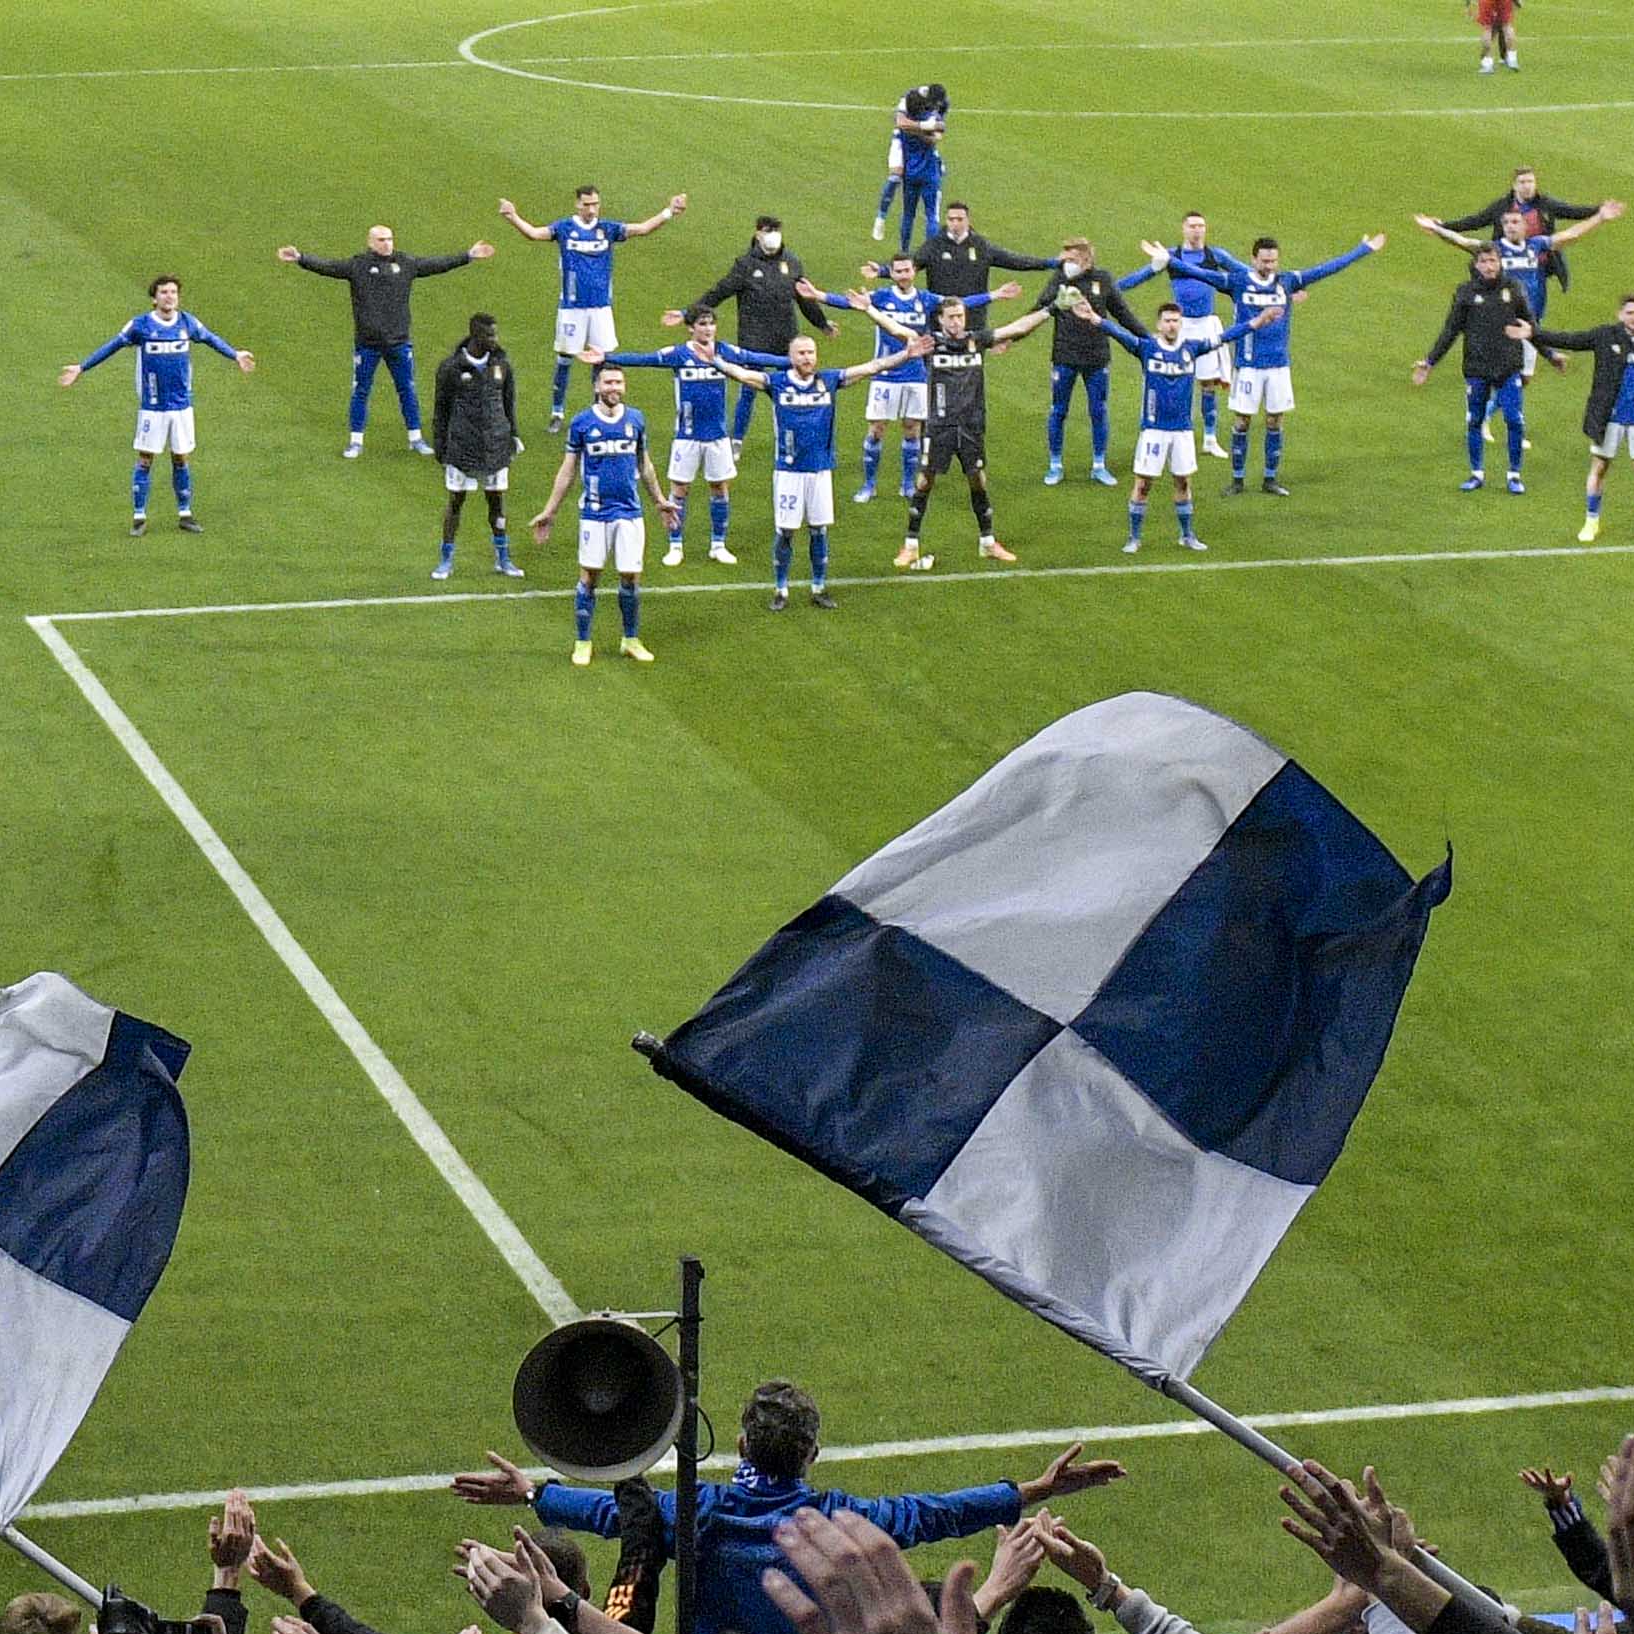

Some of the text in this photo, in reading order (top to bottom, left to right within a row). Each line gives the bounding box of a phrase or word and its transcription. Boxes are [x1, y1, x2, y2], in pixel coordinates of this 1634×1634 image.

[567, 240, 608, 251] DIGI
[146, 341, 189, 353] DIGI
[933, 354, 981, 367] DIGI
[779, 392, 831, 405] DIGI
[875, 387, 890, 400] 24
[1147, 443, 1160, 456] 14
[780, 495, 797, 510] 22
